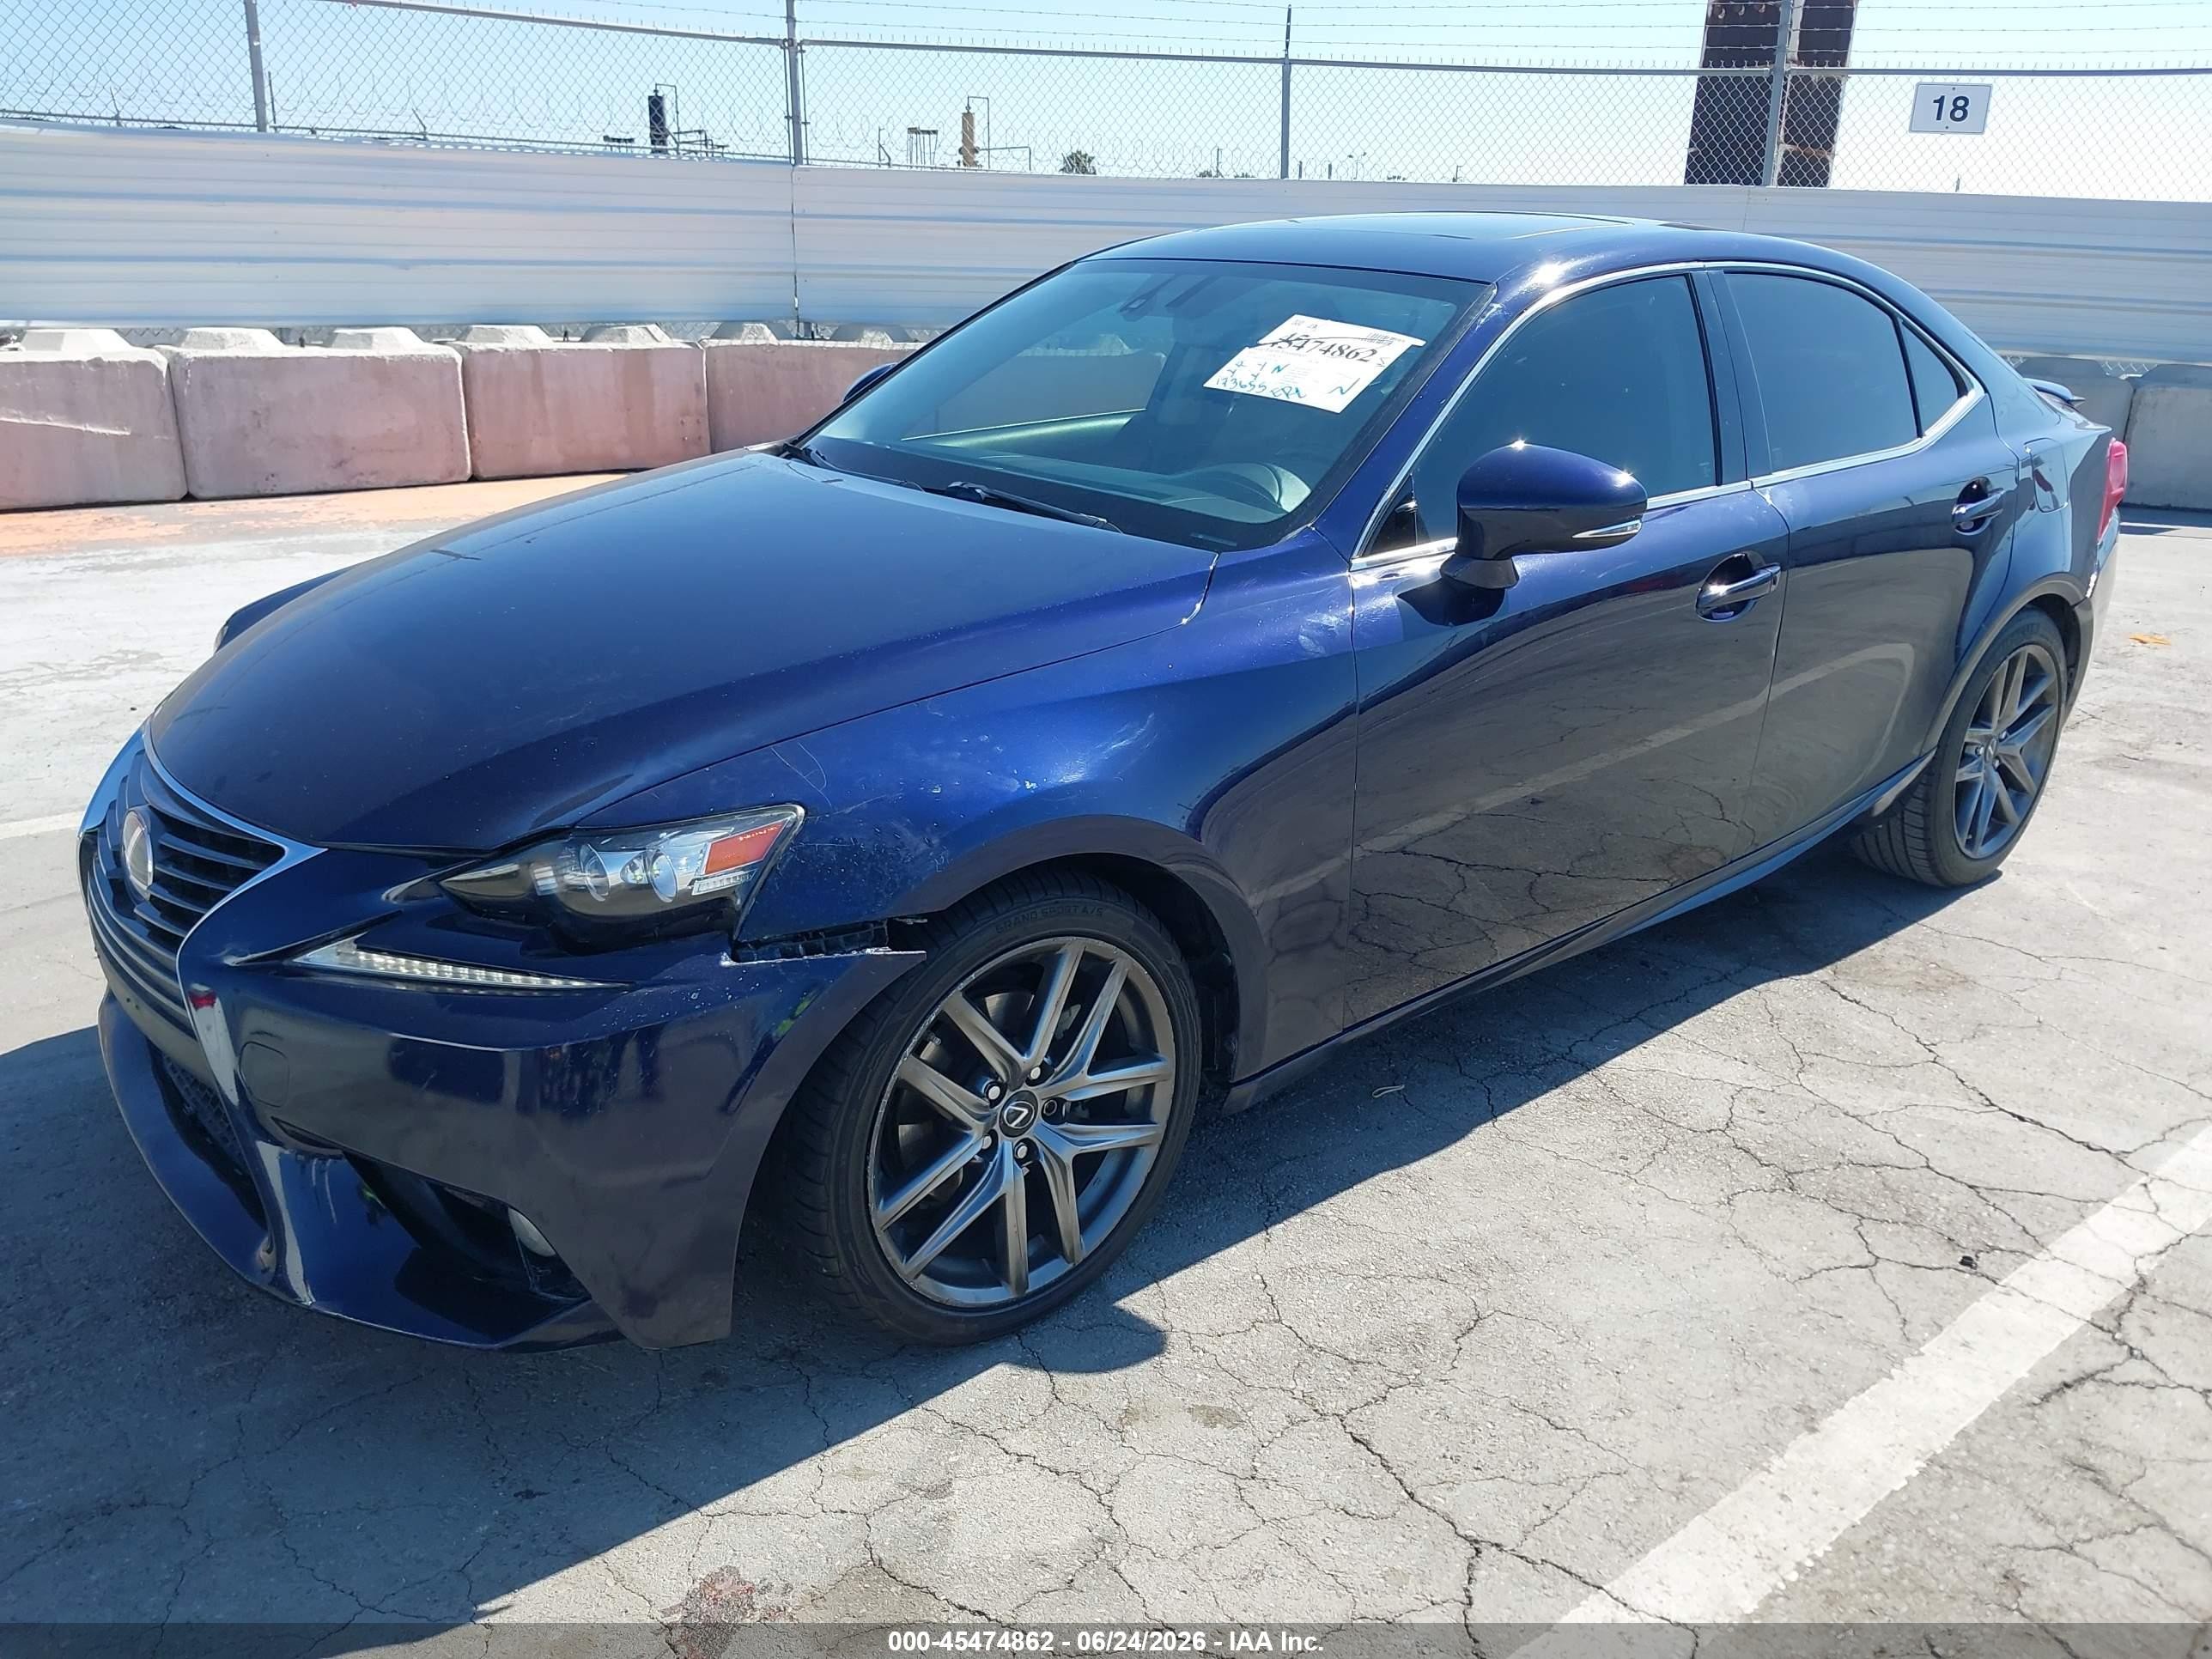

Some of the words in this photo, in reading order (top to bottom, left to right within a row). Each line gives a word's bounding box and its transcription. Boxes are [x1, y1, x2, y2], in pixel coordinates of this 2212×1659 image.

[1933, 95, 1970, 122] 18
[995, 911, 1038, 933] GRAND
[1041, 906, 1079, 916] SPORT
